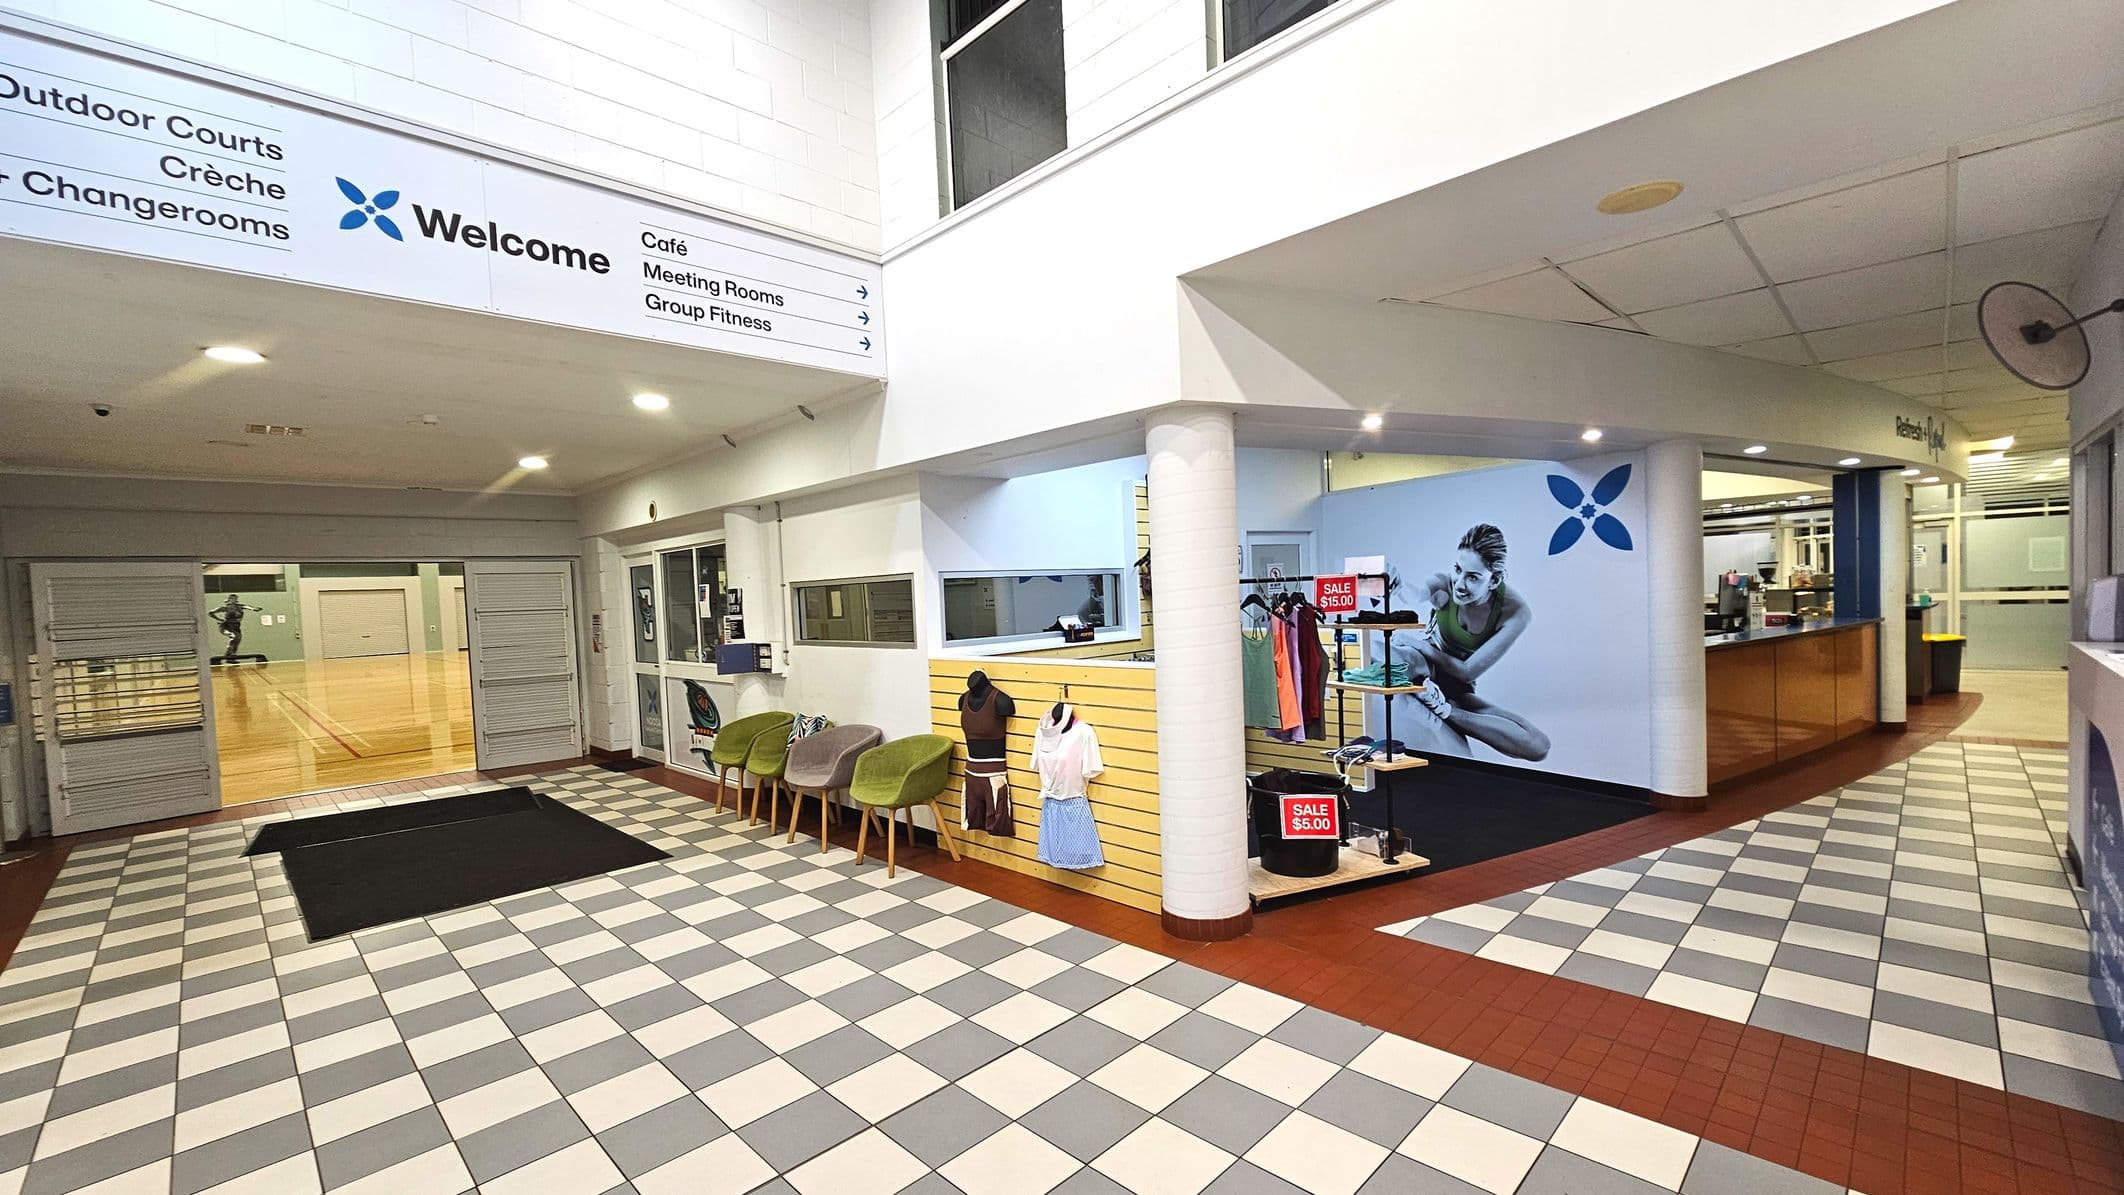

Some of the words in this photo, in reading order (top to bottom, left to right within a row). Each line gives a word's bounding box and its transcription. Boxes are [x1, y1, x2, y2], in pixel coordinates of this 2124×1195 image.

[0, 73, 155, 130] Outdoor
[166, 115, 284, 161] Courts
[160, 155, 287, 200] Crèche
[22, 170, 290, 241] Changerooms
[412, 204, 611, 275] Welcome
[641, 231, 689, 257] Café
[643, 262, 721, 296] Meeting
[724, 281, 784, 307] Rooms
[645, 293, 705, 320] Group
[709, 308, 773, 333] Fitness
[1320, 595, 1354, 608] $15.00
[1323, 583, 1351, 594] SALE
[1292, 817, 1331, 831] $5.00
[1293, 803, 1329, 816] SALE
